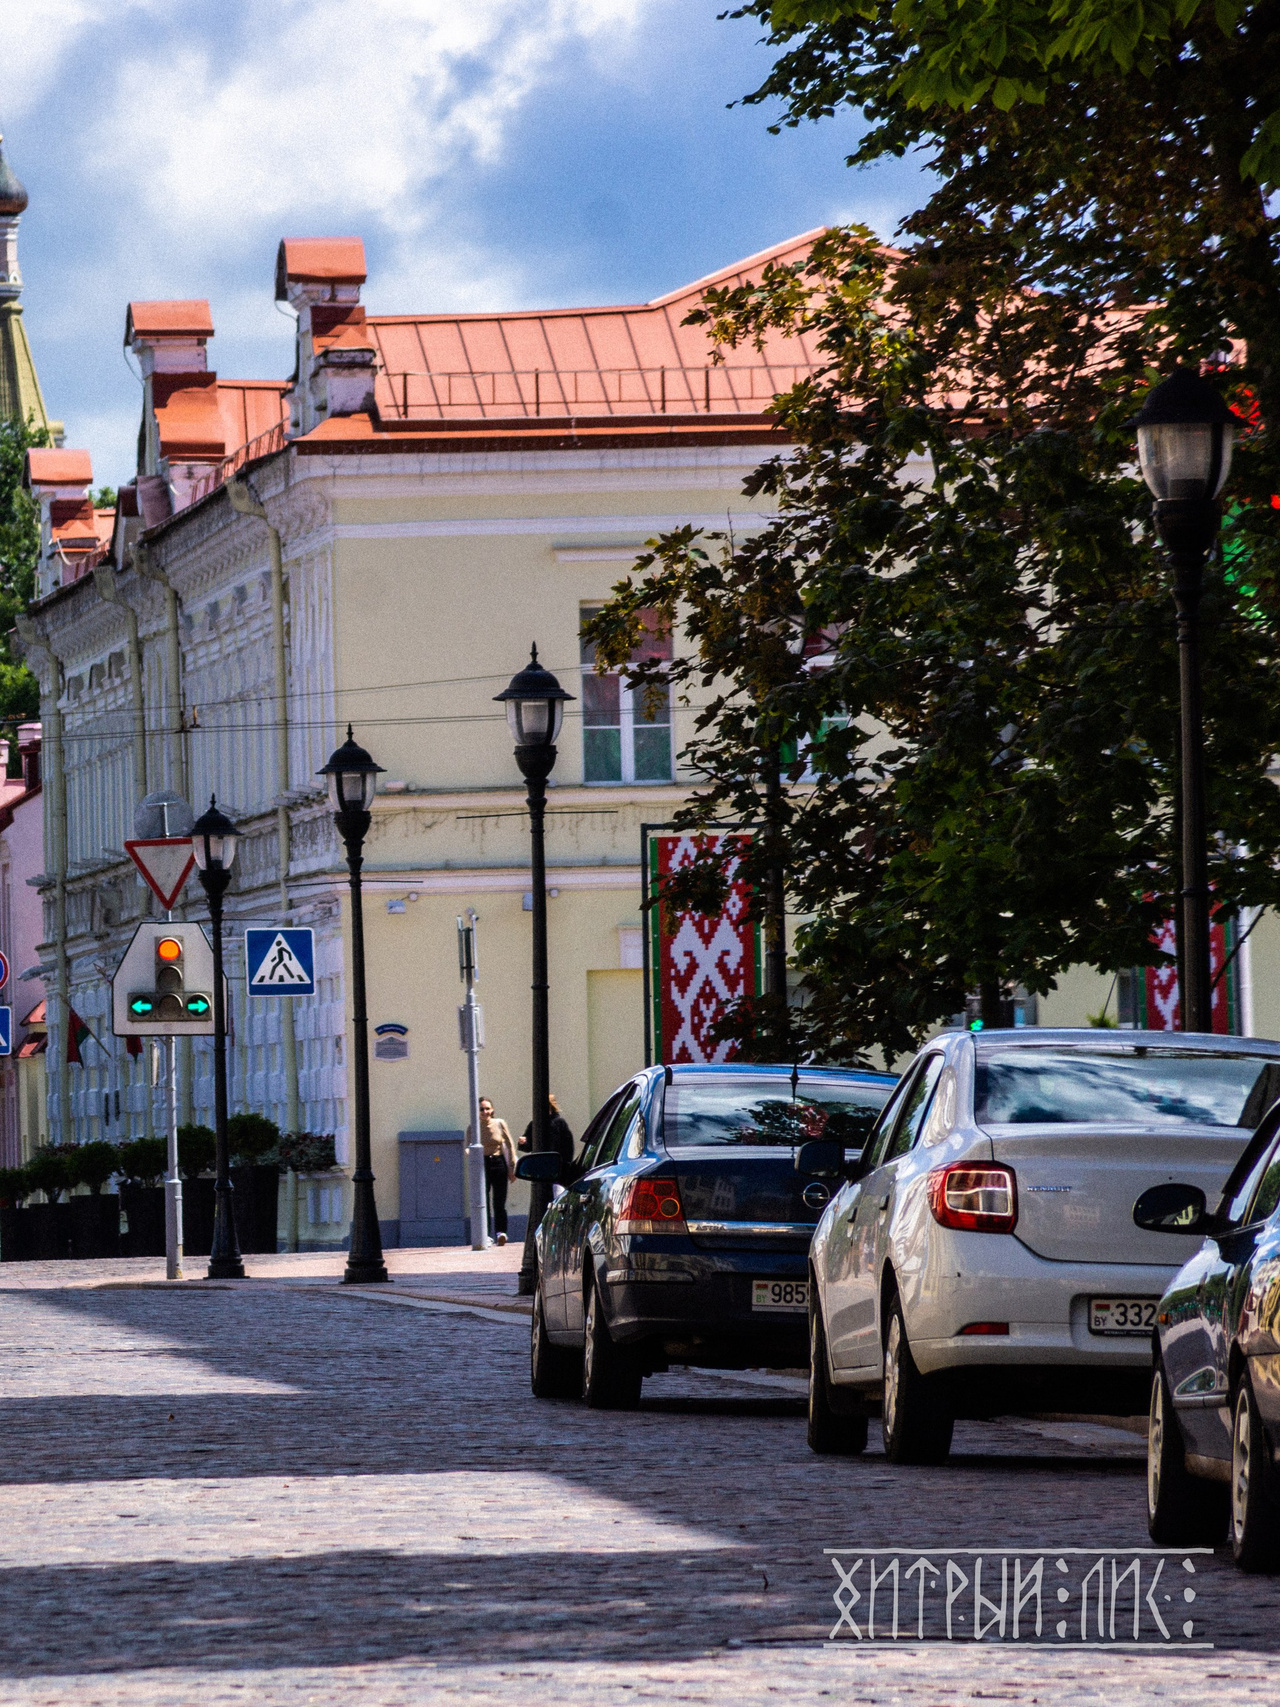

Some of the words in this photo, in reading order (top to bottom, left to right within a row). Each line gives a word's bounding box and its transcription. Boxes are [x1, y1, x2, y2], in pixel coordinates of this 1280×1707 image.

[756, 1294, 767, 1303] BY
[771, 1283, 809, 1304] 985
[1094, 1316, 1107, 1327] BY
[1115, 1302, 1157, 1327] 332
